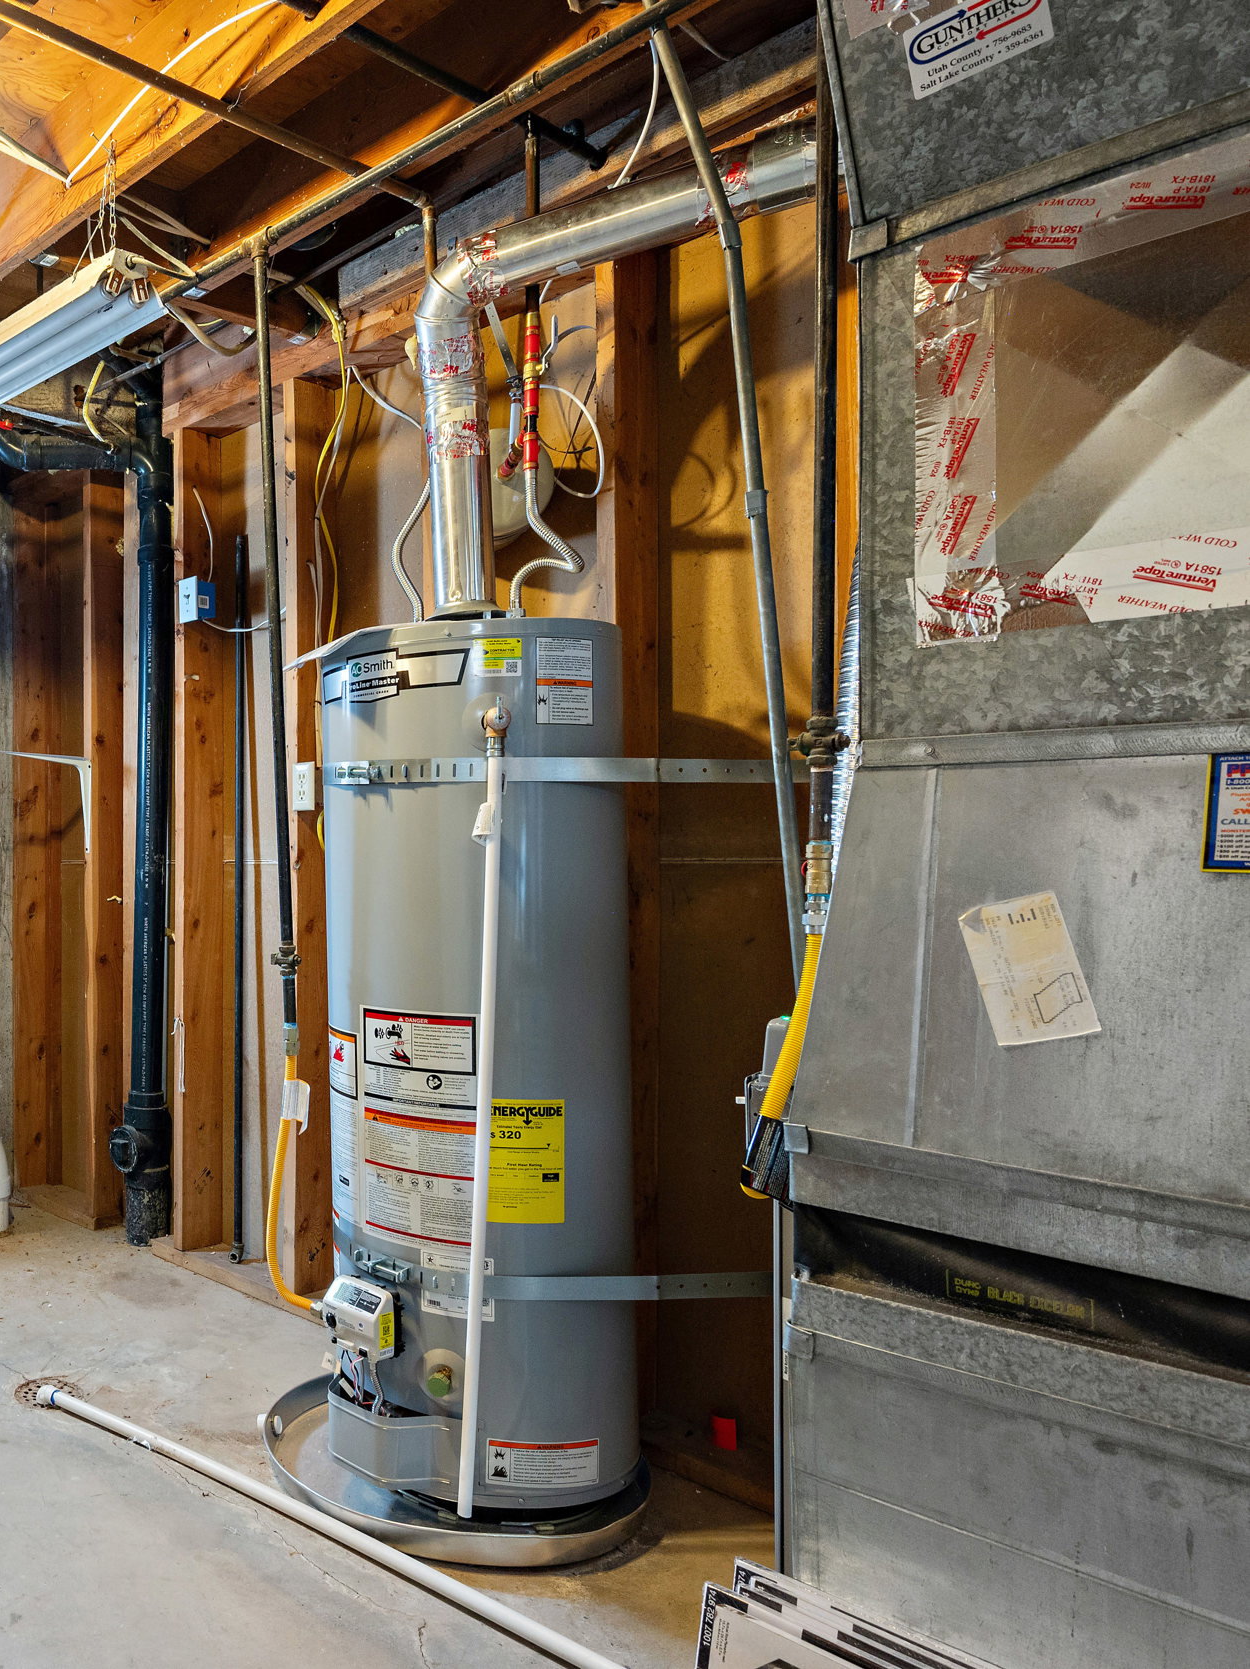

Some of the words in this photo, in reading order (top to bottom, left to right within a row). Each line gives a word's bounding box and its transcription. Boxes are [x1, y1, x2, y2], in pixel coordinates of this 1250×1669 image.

[927, 63, 948, 78] Utah
[950, 48, 983, 68] County
[992, 23, 1032, 48] 756-9683
[920, 79, 937, 92] Salt
[938, 70, 960, 84] Lake
[961, 54, 994, 74] County
[1005, 30, 1044, 54] 359-6361
[1067, 198, 1097, 206] COLD
[1050, 225, 1084, 234] 1581A
[1204, 536, 1238, 548] COLD
[1185, 561, 1222, 576] 1581A
[1117, 594, 1168, 611] WEATHER
[363, 660, 393, 673] Smith
[372, 677, 400, 687] Master
[499, 1130, 522, 1139] 320
[707, 1588, 718, 1607] 974
[705, 1606, 715, 1625] 782
[702, 1624, 713, 1647] 1007
